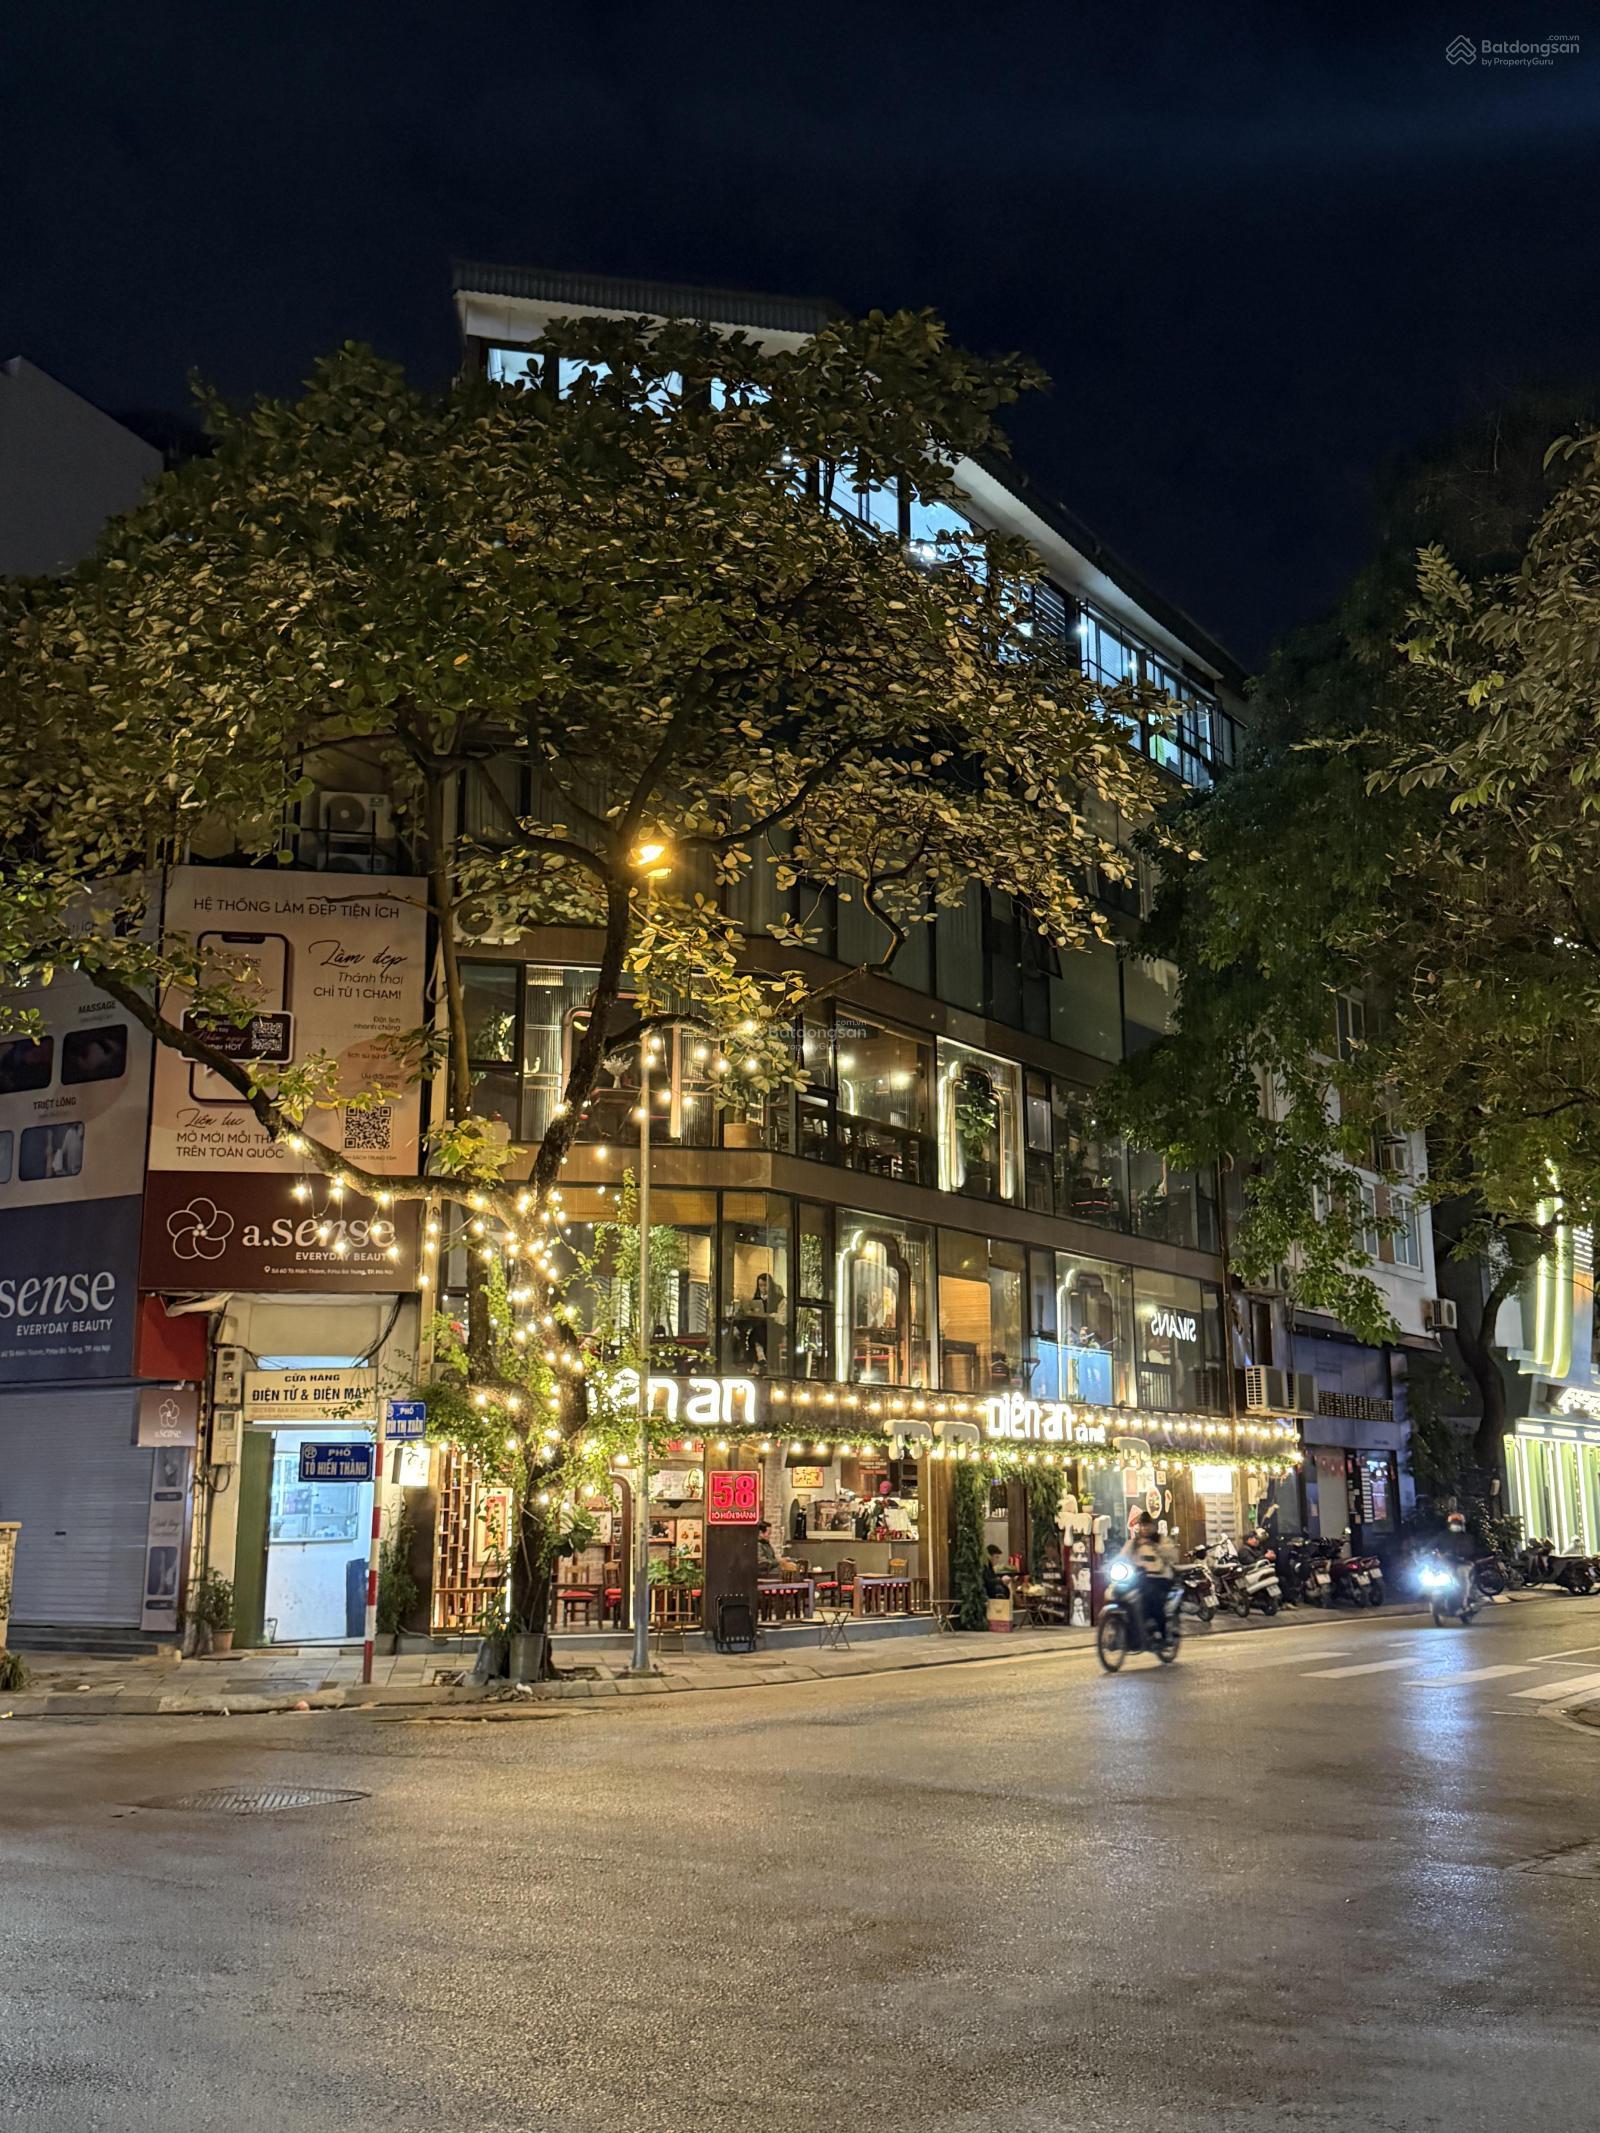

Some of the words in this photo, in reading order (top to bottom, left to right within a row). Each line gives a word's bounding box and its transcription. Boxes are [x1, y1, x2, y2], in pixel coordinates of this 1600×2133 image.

[194, 896, 212, 911] HỆ
[218, 897, 270, 913] THỐNG
[308, 901, 336, 916] ĐẸP
[342, 902, 370, 918] TIỆN
[308, 939, 366, 968] Làm
[372, 945, 408, 976] đẹp
[356, 988, 360, 998] 1
[79, 1000, 116, 1014] MASSAGE
[176, 1145, 206, 1158] TRÊN
[210, 1146, 244, 1158] TOÀN
[246, 1146, 285, 1159] QUỐC
[242, 1218, 396, 1248] a.sense
[296, 1251, 351, 1261] EVERYDAY
[354, 1252, 388, 1262] BEAUT
[0, 1271, 116, 1318] sense
[16, 1322, 69, 1336] EVERYDAY
[72, 1318, 113, 1333] BEAUTY
[284, 1373, 306, 1382] CỬA
[252, 1387, 280, 1402] ĐIỆN
[283, 1384, 299, 1400] TỬ
[300, 1388, 310, 1400] &
[313, 1386, 340, 1402] ĐIỆN
[686, 1378, 756, 1424] an
[400, 1405, 415, 1415] PHỐ
[328, 1446, 352, 1457] PHỐ
[317, 1458, 336, 1476] HIẾN
[340, 1458, 368, 1476] THÀNH
[714, 1475, 756, 1508] 58
